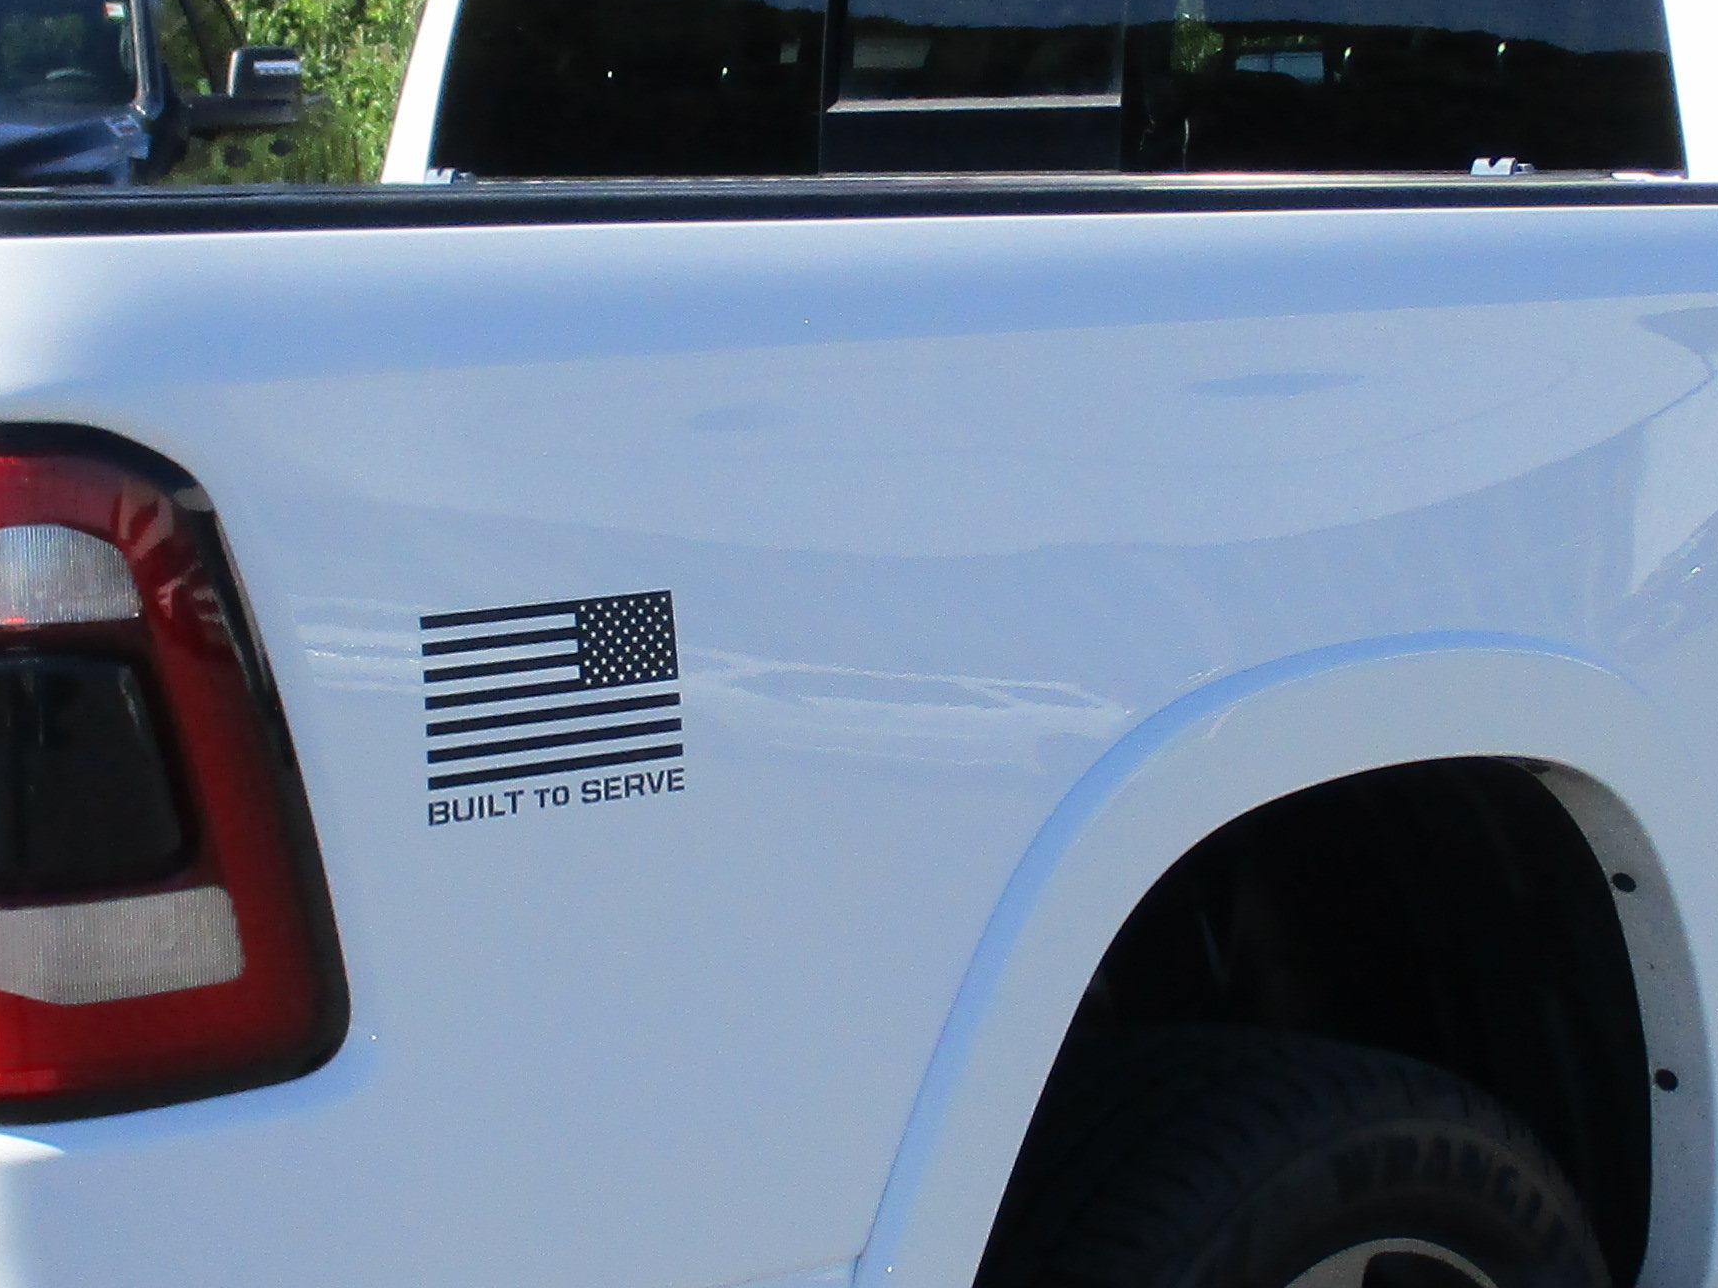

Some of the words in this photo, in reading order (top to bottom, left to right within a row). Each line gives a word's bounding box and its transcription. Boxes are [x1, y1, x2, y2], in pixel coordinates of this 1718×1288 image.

[428, 789, 525, 826] BUILT
[534, 785, 570, 808] TO
[581, 767, 685, 804] SERVE
